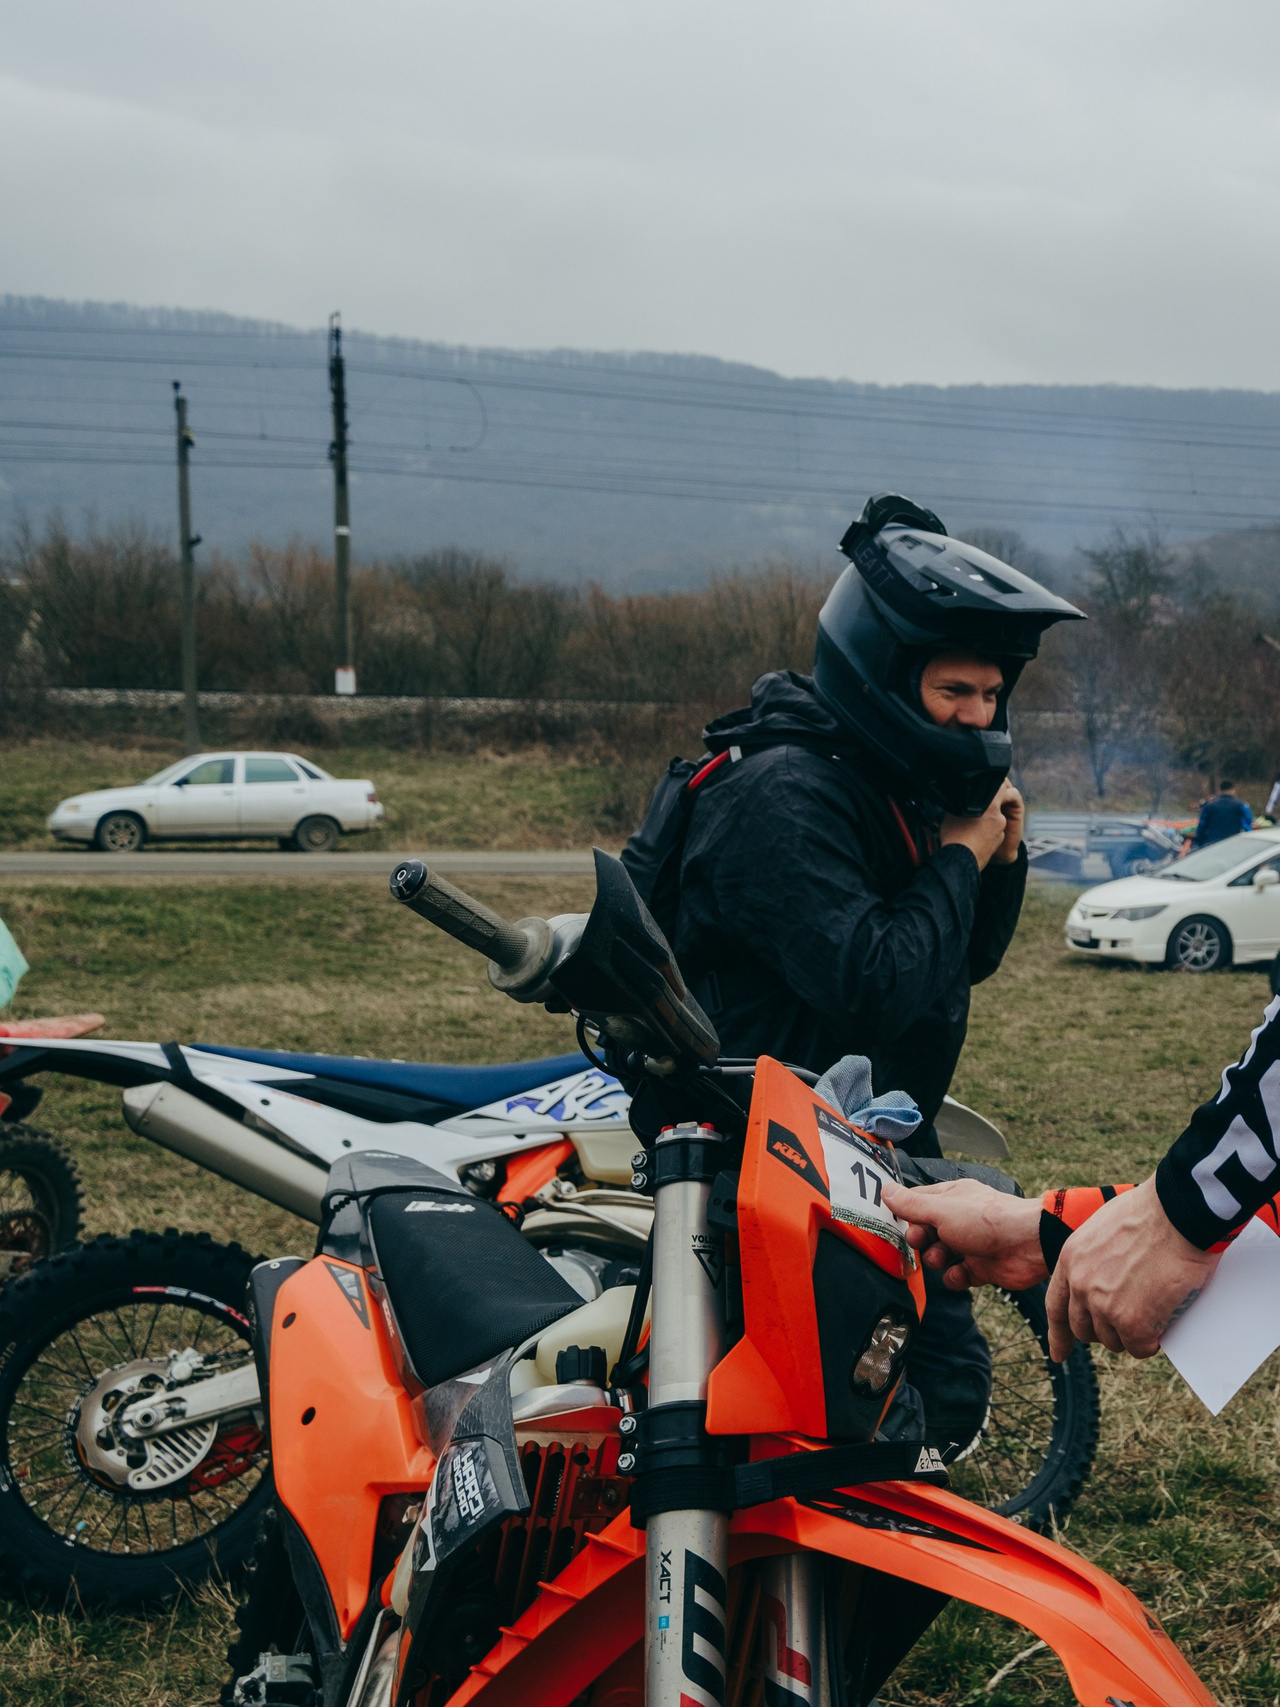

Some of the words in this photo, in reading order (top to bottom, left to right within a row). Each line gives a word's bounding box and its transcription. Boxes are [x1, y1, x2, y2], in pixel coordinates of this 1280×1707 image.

[854, 542, 894, 588] LEATT
[772, 1141, 808, 1170] KTM
[453, 1454, 470, 1518] ENDURO
[461, 1450, 485, 1518] HARD
[659, 1549, 673, 1604] XACT
